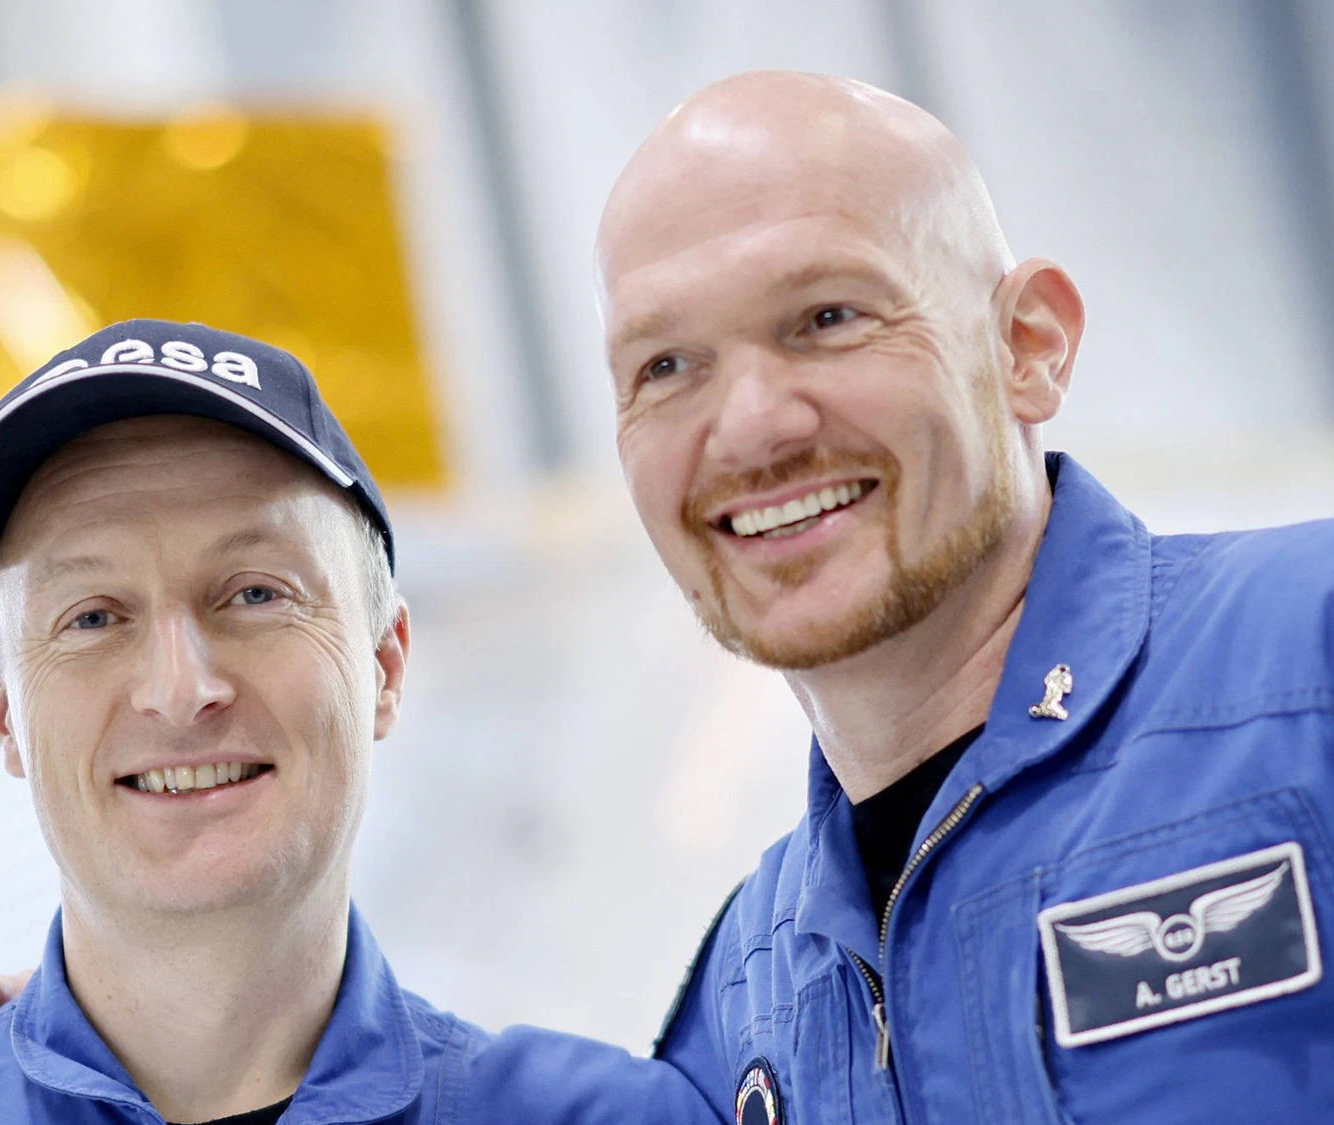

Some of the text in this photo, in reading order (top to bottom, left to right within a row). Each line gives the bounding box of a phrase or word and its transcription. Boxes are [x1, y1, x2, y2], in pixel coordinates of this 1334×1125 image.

[100, 338, 262, 391] esa
[1136, 957, 1242, 1009] A. GERST
